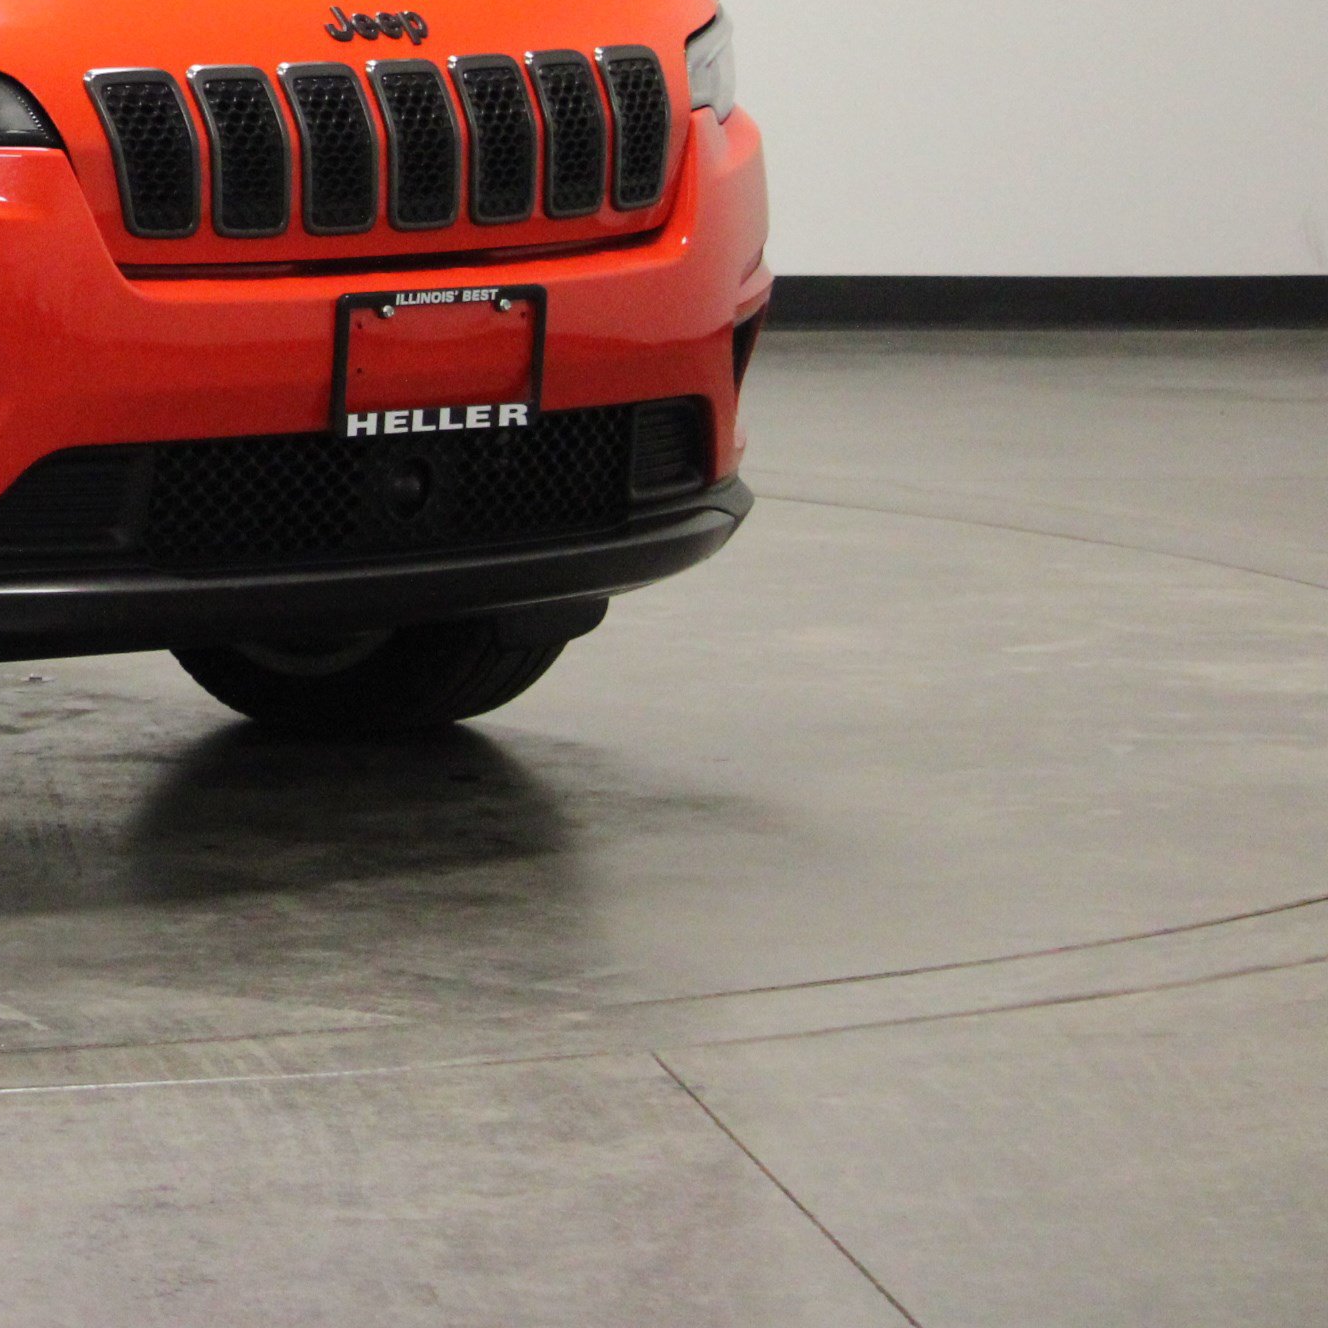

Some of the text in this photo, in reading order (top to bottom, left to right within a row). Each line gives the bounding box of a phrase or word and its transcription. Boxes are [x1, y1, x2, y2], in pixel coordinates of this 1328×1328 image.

[325, 6, 428, 45] Jeep
[395, 288, 499, 306] ILLINOIS' BEST
[347, 403, 528, 437] HELLER
